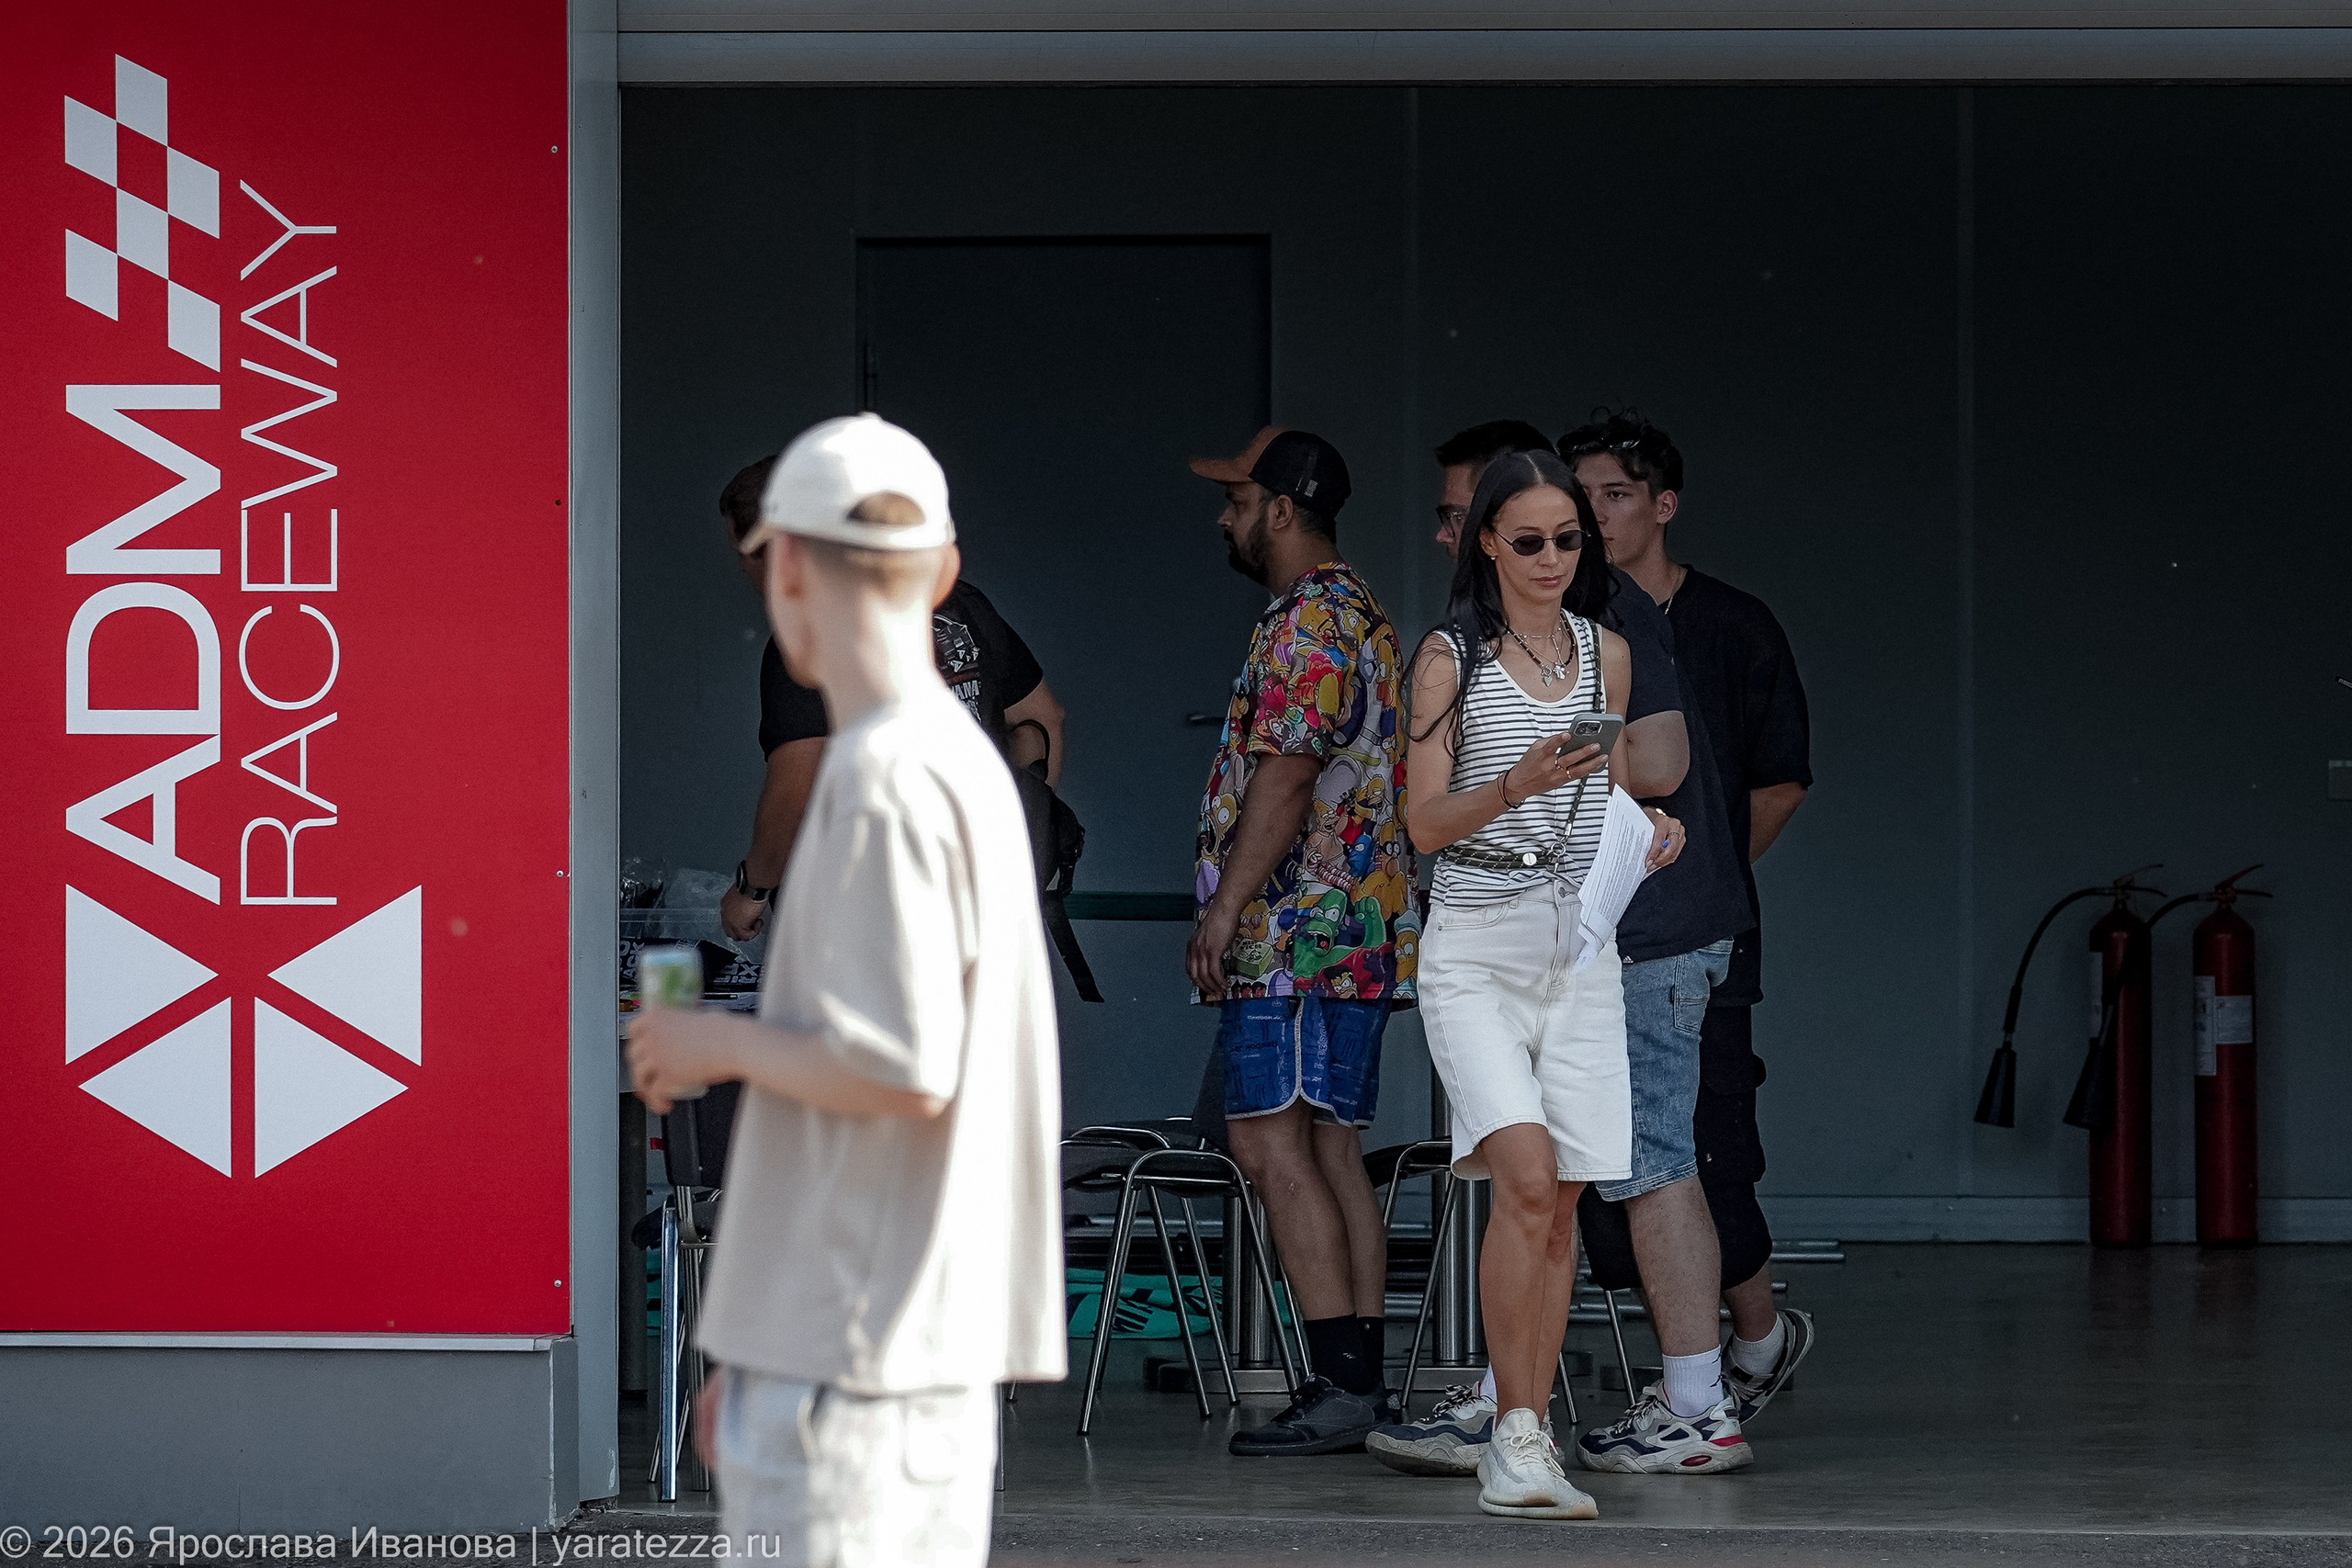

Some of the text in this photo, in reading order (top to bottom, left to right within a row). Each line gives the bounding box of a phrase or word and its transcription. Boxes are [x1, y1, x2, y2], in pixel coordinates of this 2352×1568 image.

[66, 384, 221, 905] ADM
[239, 179, 339, 906] RACEWAY
[952, 681, 979, 699] ANA
